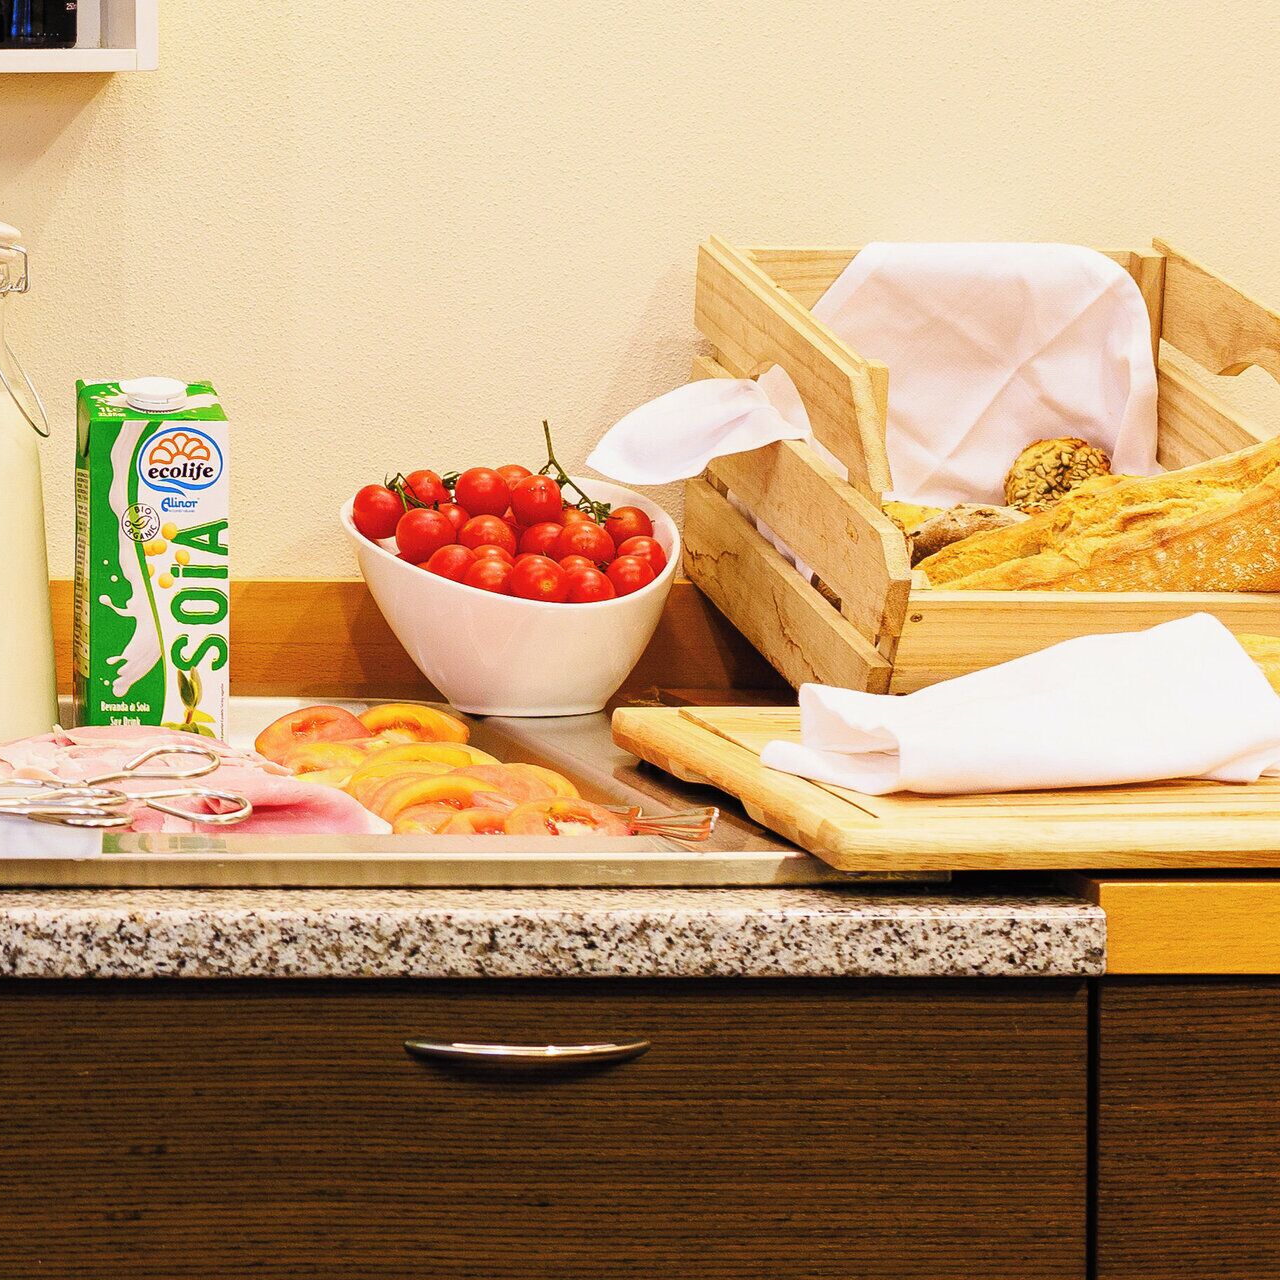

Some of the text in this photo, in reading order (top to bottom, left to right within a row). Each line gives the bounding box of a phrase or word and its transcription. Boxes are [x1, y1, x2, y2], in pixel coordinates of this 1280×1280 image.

[148, 462, 214, 480] ecolife
[134, 506, 152, 515] BIO
[161, 497, 198, 512] Alinor
[125, 520, 158, 540] ORGANIC
